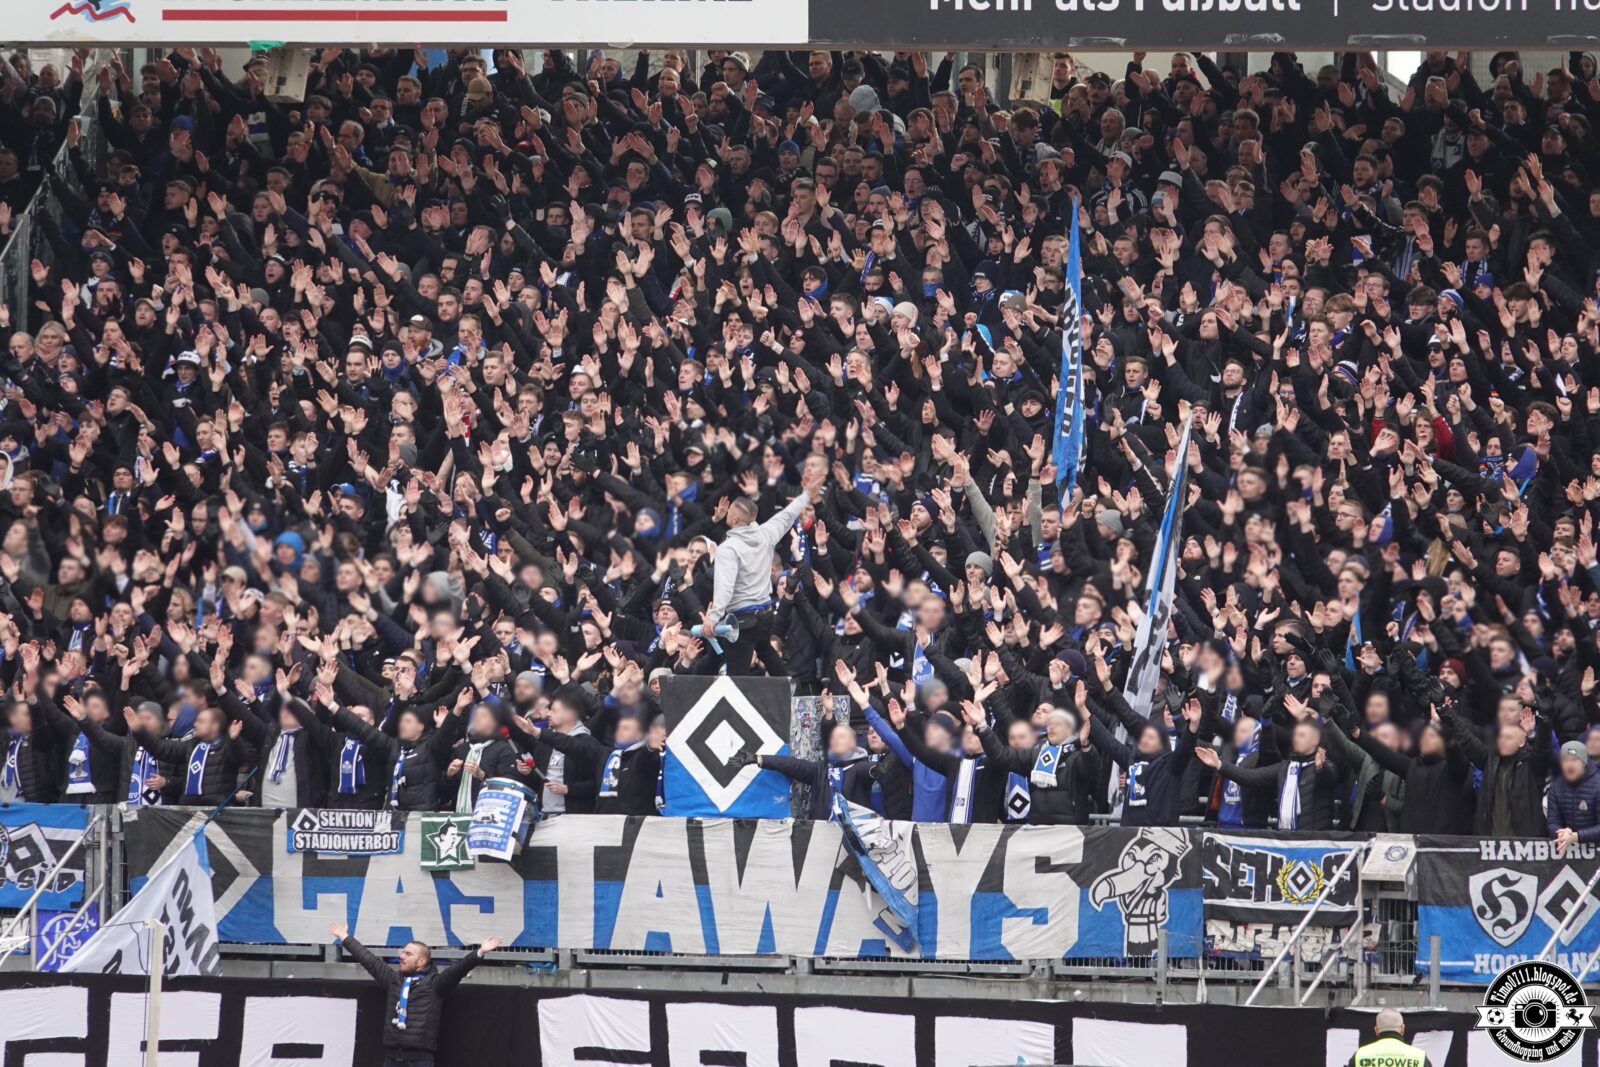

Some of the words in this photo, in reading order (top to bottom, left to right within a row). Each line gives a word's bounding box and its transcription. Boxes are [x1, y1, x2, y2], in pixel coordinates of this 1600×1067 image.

[319, 810, 375, 829] SEKTION
[294, 832, 399, 851] STADIONVERBOT
[1377, 1057, 1420, 1067] POWER
